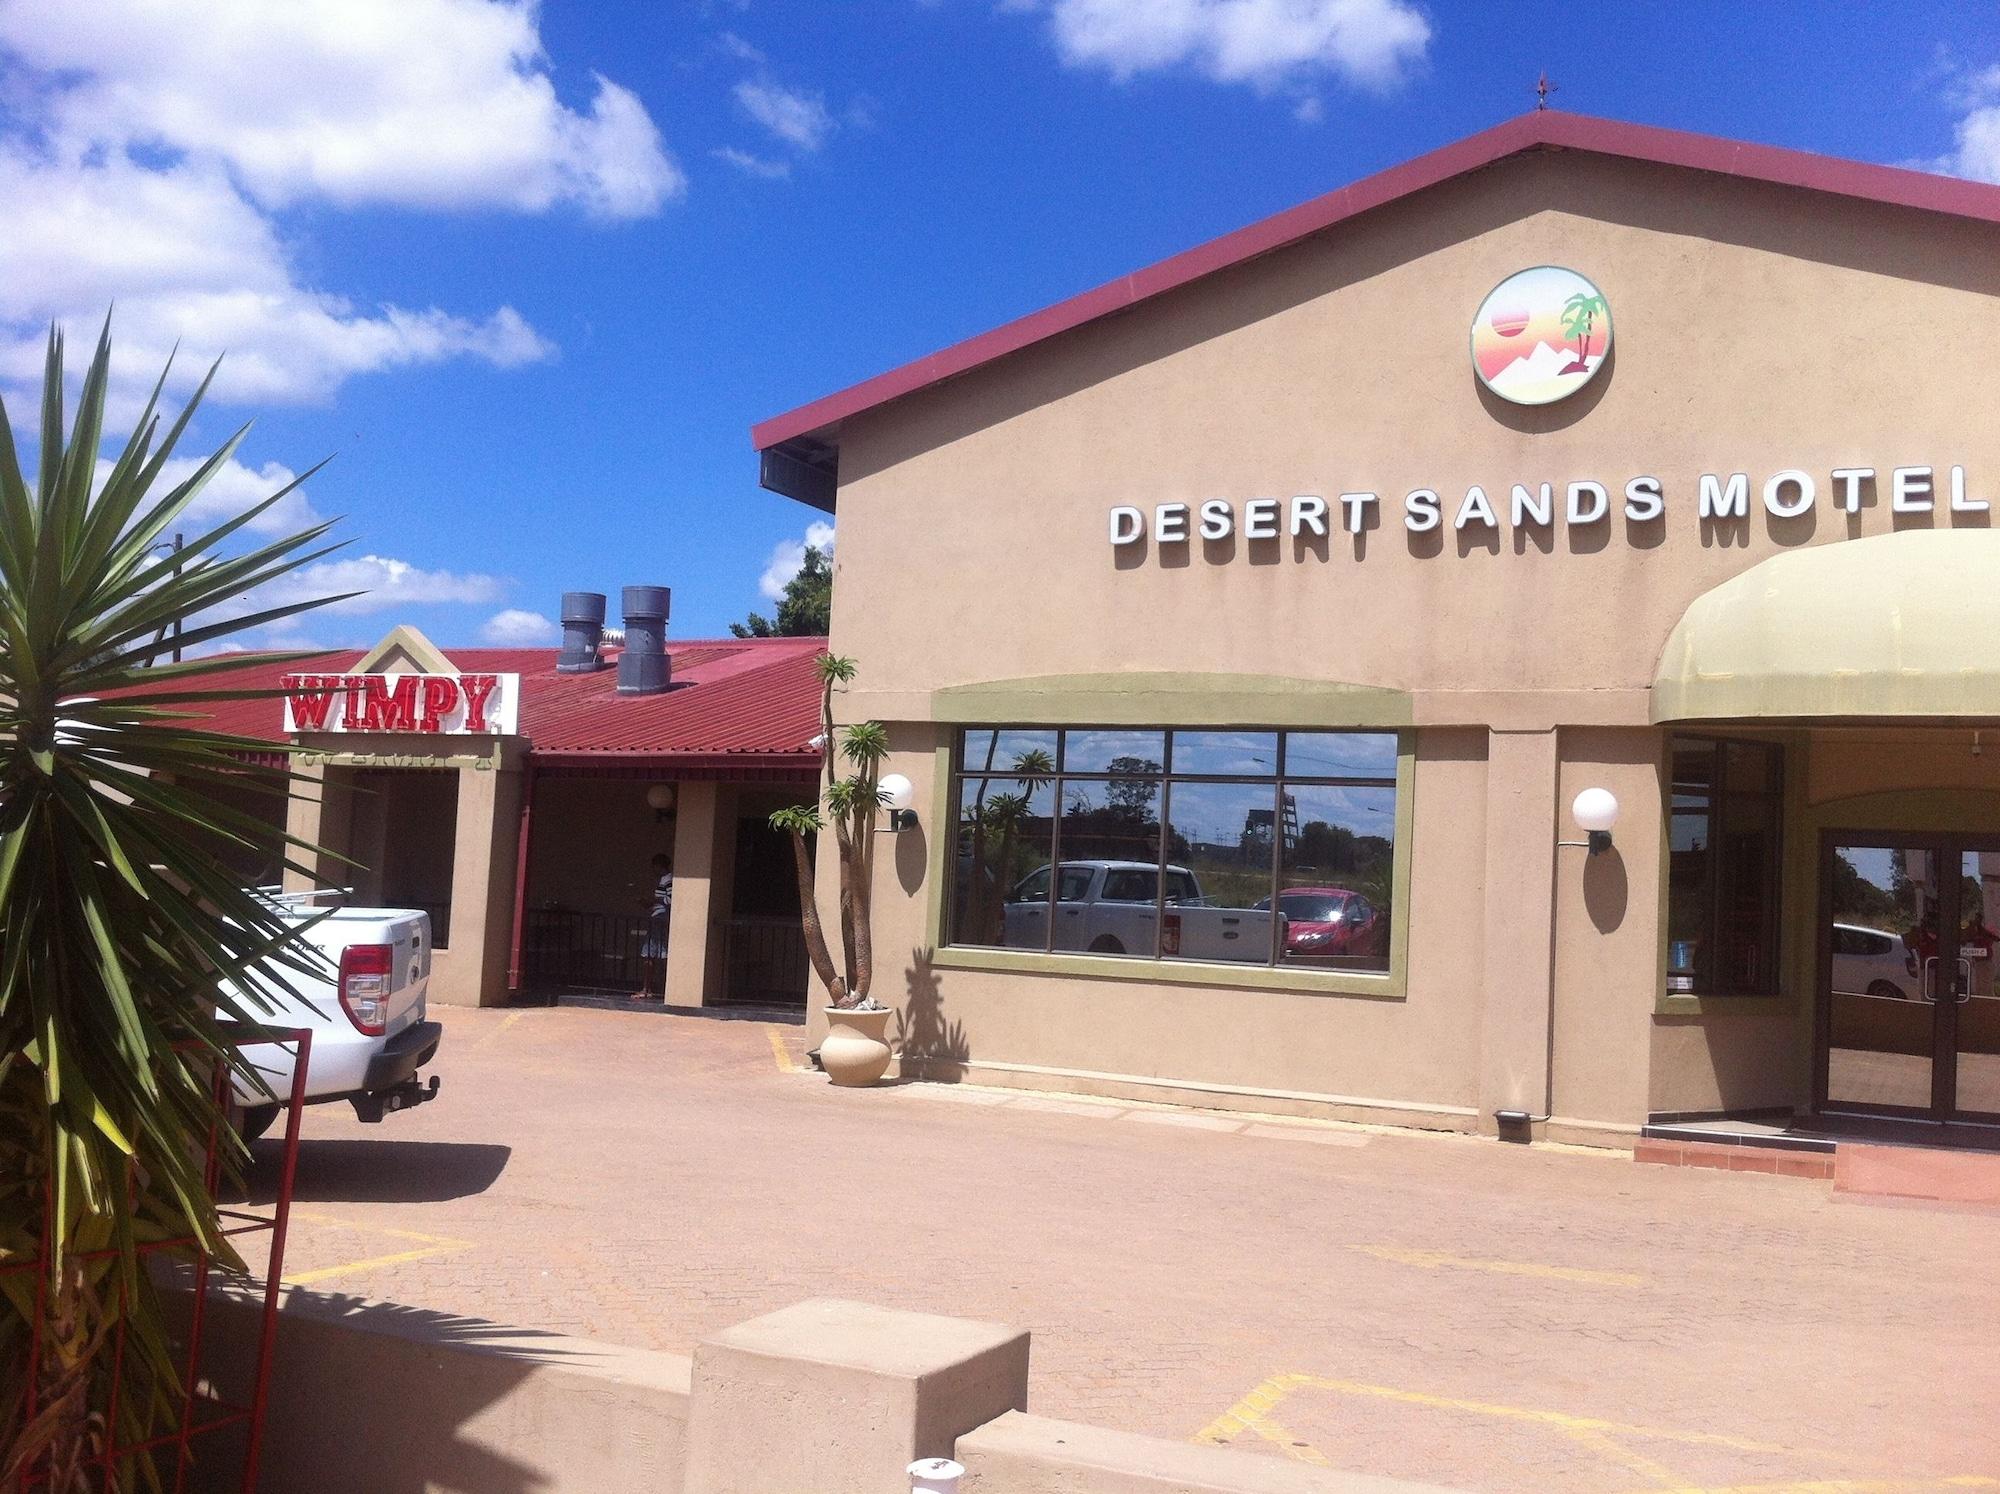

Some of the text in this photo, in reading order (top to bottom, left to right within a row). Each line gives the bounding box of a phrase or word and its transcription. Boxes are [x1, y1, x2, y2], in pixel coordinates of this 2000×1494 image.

[1108, 464, 1991, 545] DESERT SANDS MOTEL
[280, 674, 498, 732] WIMPY
